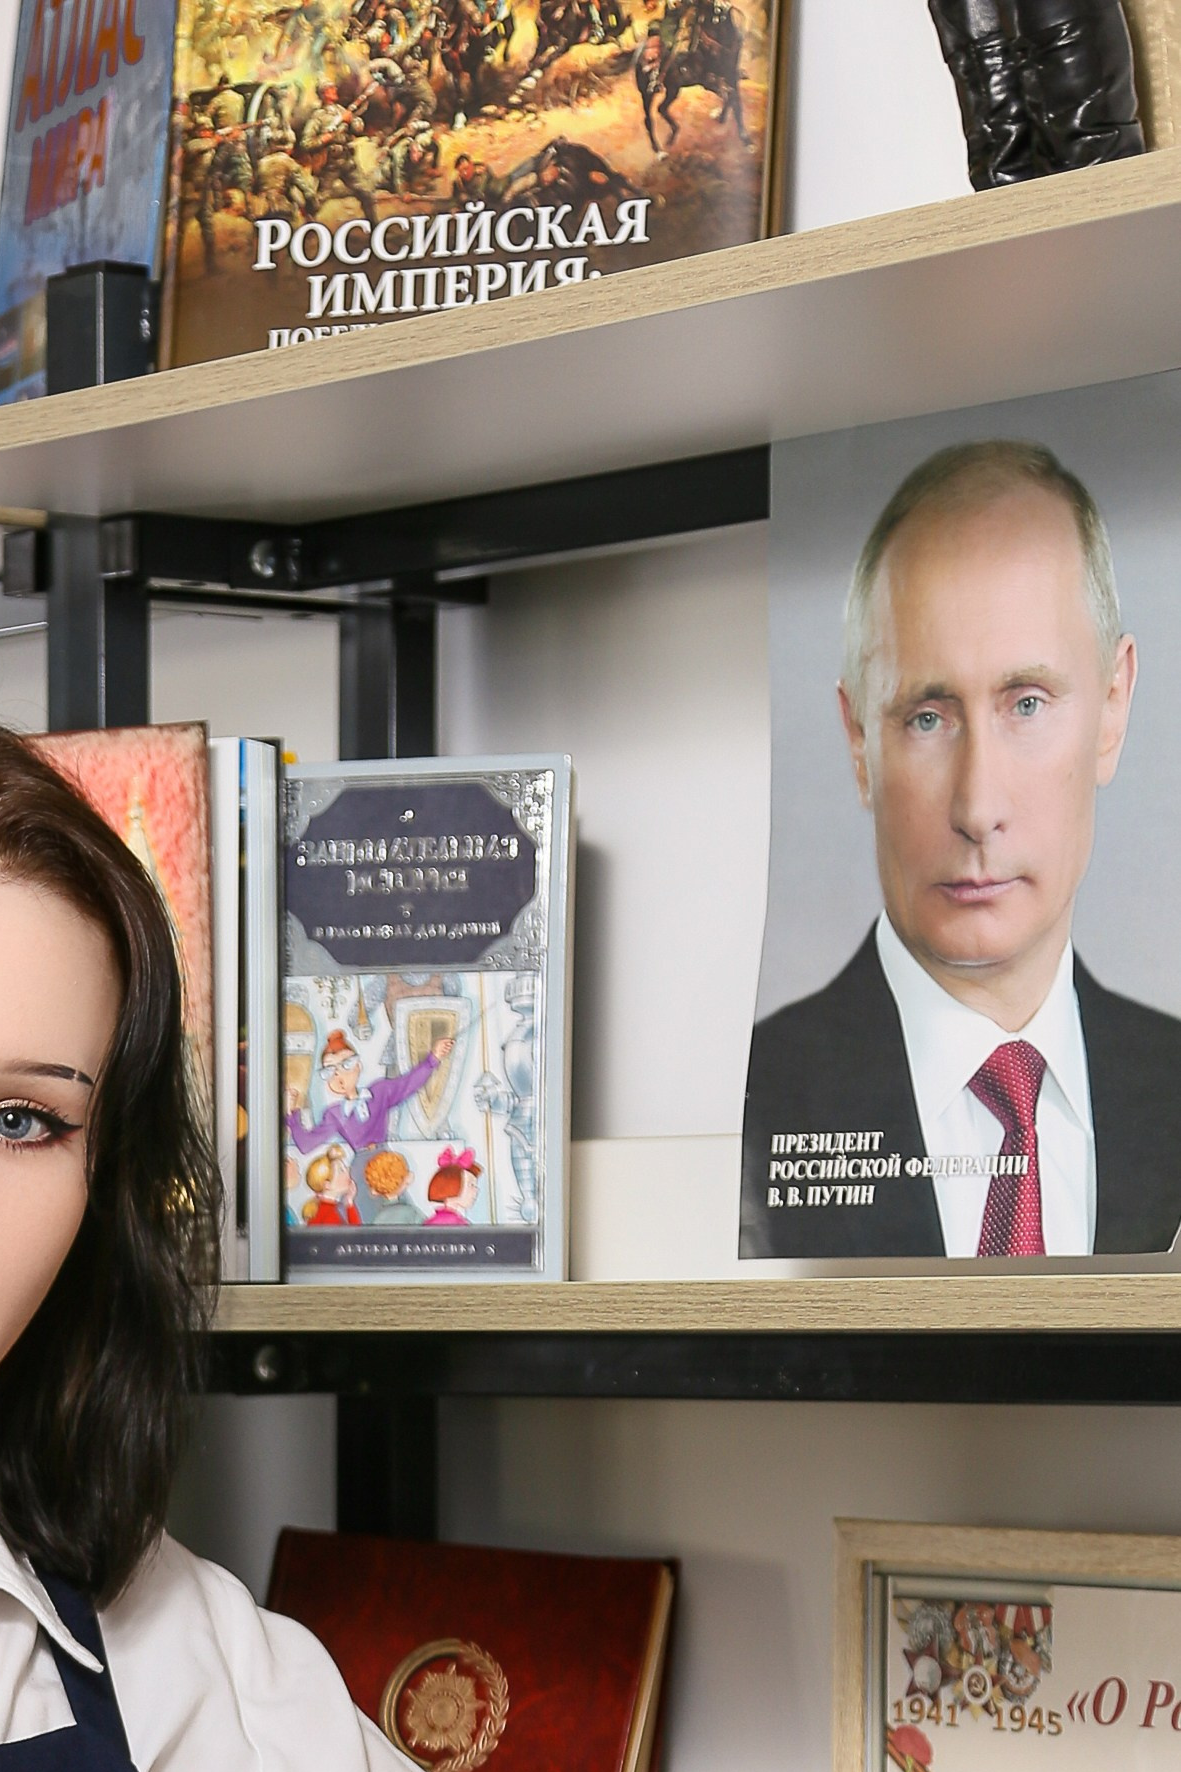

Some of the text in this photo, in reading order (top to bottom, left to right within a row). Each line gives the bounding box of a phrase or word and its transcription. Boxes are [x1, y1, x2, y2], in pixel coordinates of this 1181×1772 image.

[24, 94, 111, 226] МИРА
[251, 199, 652, 271] РОССИЙСКАЯ
[771, 1131, 885, 1155] ПРЕЗИДЕНТ
[768, 1153, 1030, 1181] РОССИЙСКОЙ ФЕДЕРАЦИИ
[767, 1184, 876, 1208] В. В. ПУТИН
[893, 1697, 1064, 1736] 1941 1945
[1067, 1676, 1128, 1726] «О
